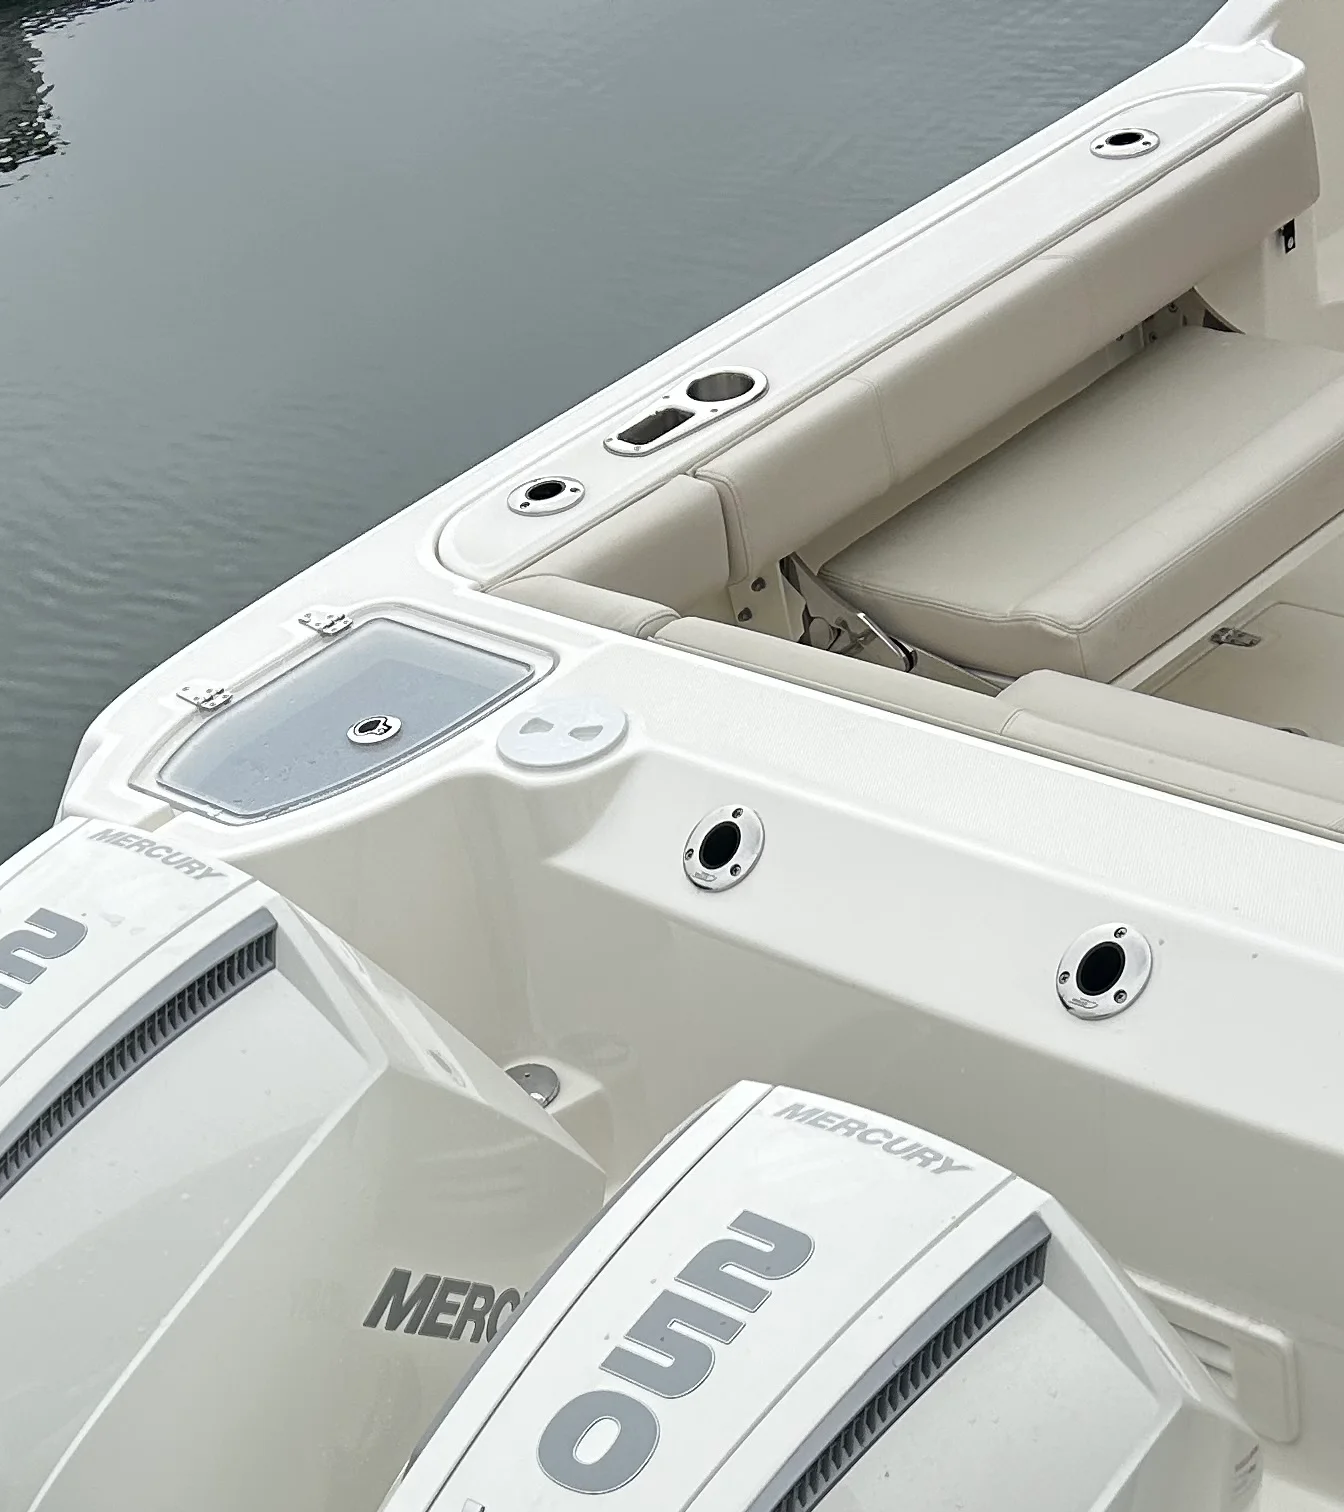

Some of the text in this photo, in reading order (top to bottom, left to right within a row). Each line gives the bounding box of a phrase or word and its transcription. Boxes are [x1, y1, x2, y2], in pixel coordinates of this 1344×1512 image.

[86, 827, 226, 885] MERCURY
[773, 1101, 976, 1177] MERCURY
[362, 1267, 529, 1344] MERC
[536, 1209, 816, 1496] 250
